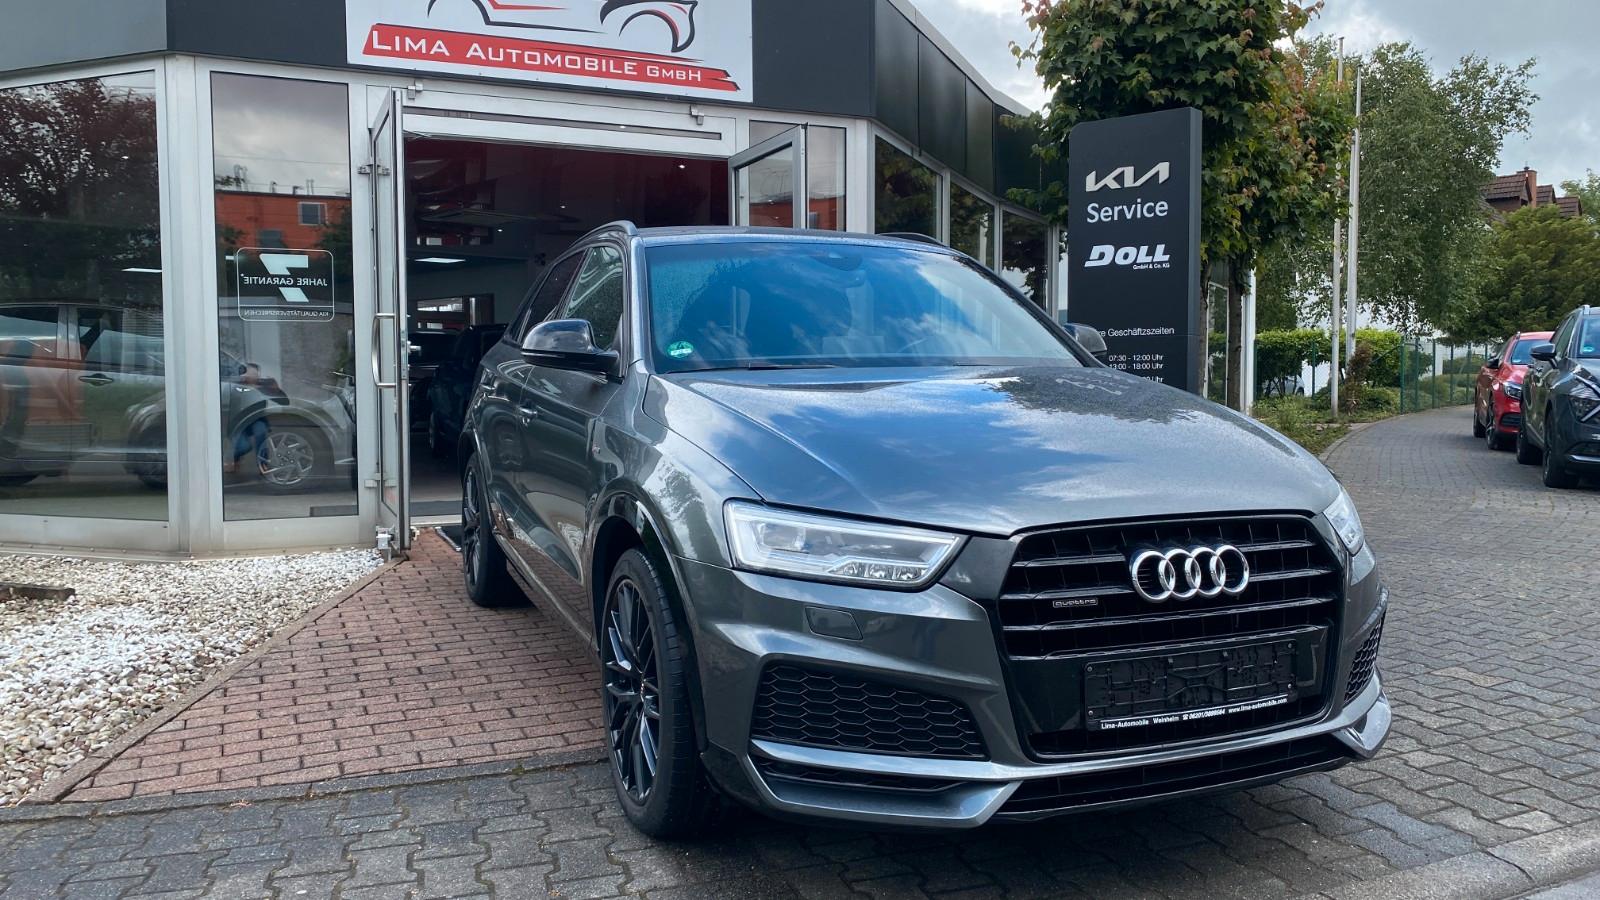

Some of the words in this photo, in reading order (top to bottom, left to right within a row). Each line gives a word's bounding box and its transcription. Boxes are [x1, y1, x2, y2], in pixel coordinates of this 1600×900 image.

[372, 30, 450, 56] LIMA
[465, 42, 637, 75] AUTOMOBILE
[1085, 161, 1170, 192] KIA
[1087, 198, 1169, 223] Service
[1084, 244, 1170, 267] DOLL
[1108, 354, 1127, 362] 07:30
[1101, 718, 1149, 730] Lima-Automobile
